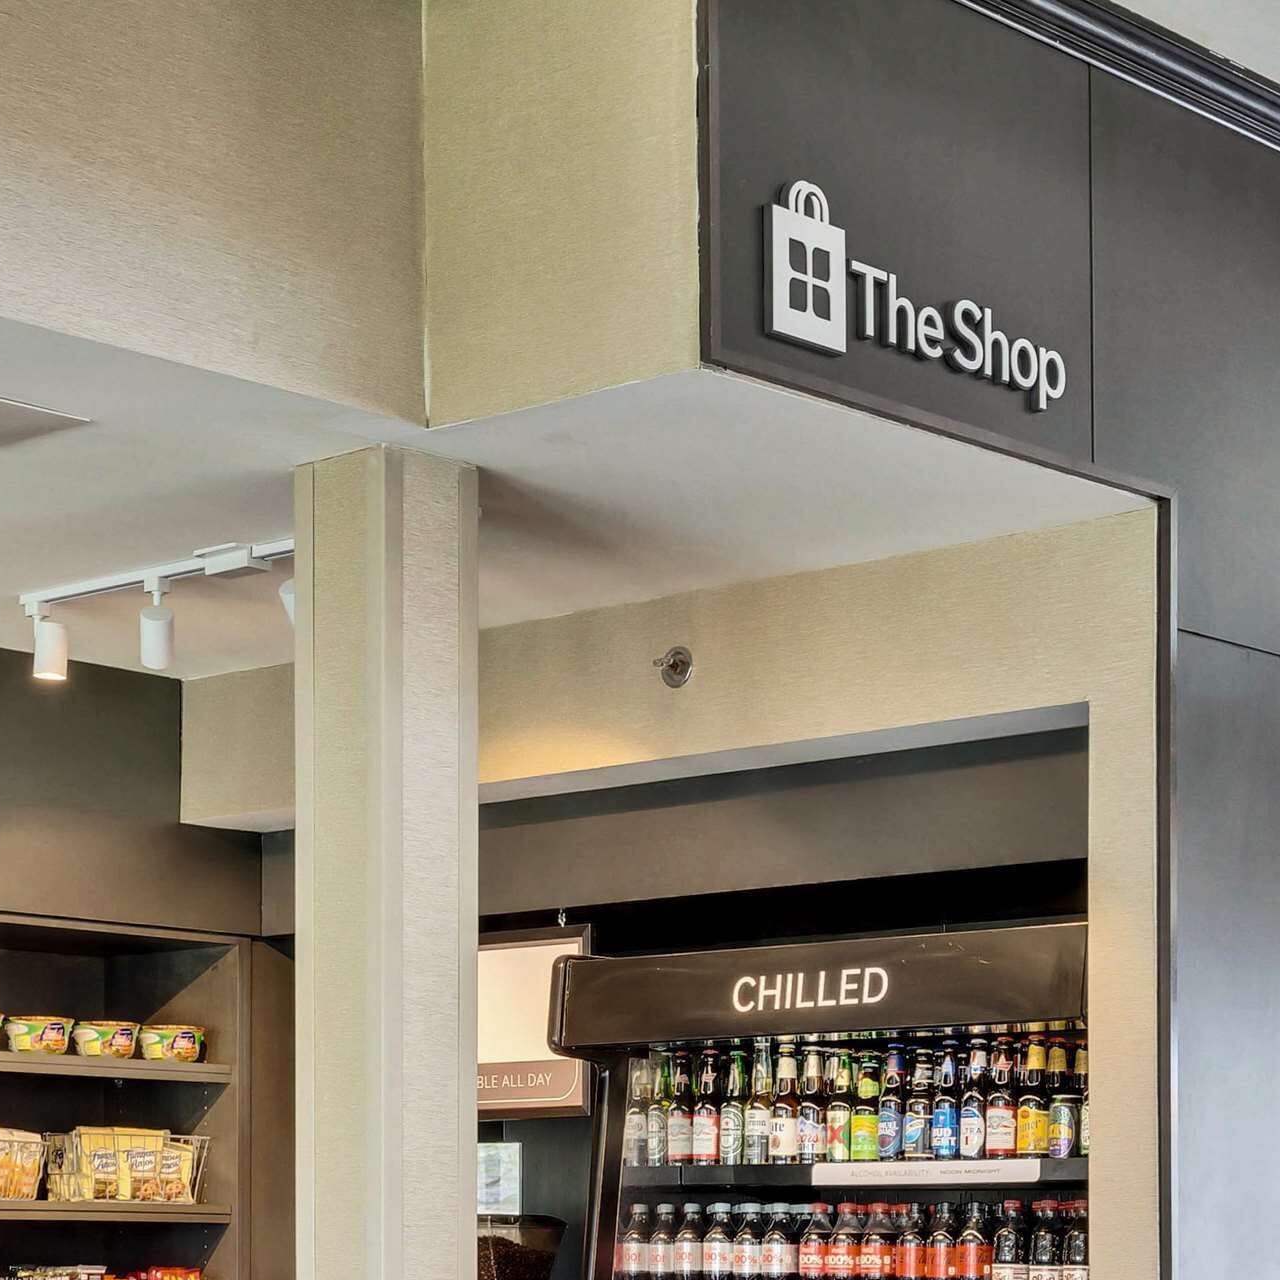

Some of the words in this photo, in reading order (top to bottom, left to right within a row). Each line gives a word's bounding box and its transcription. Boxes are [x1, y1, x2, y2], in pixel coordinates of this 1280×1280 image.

[850, 259, 945, 360] The
[949, 299, 1066, 411] Shop
[732, 966, 889, 1013] CHILLED
[502, 1074, 525, 1088] ALL
[527, 1072, 552, 1087] DAY
